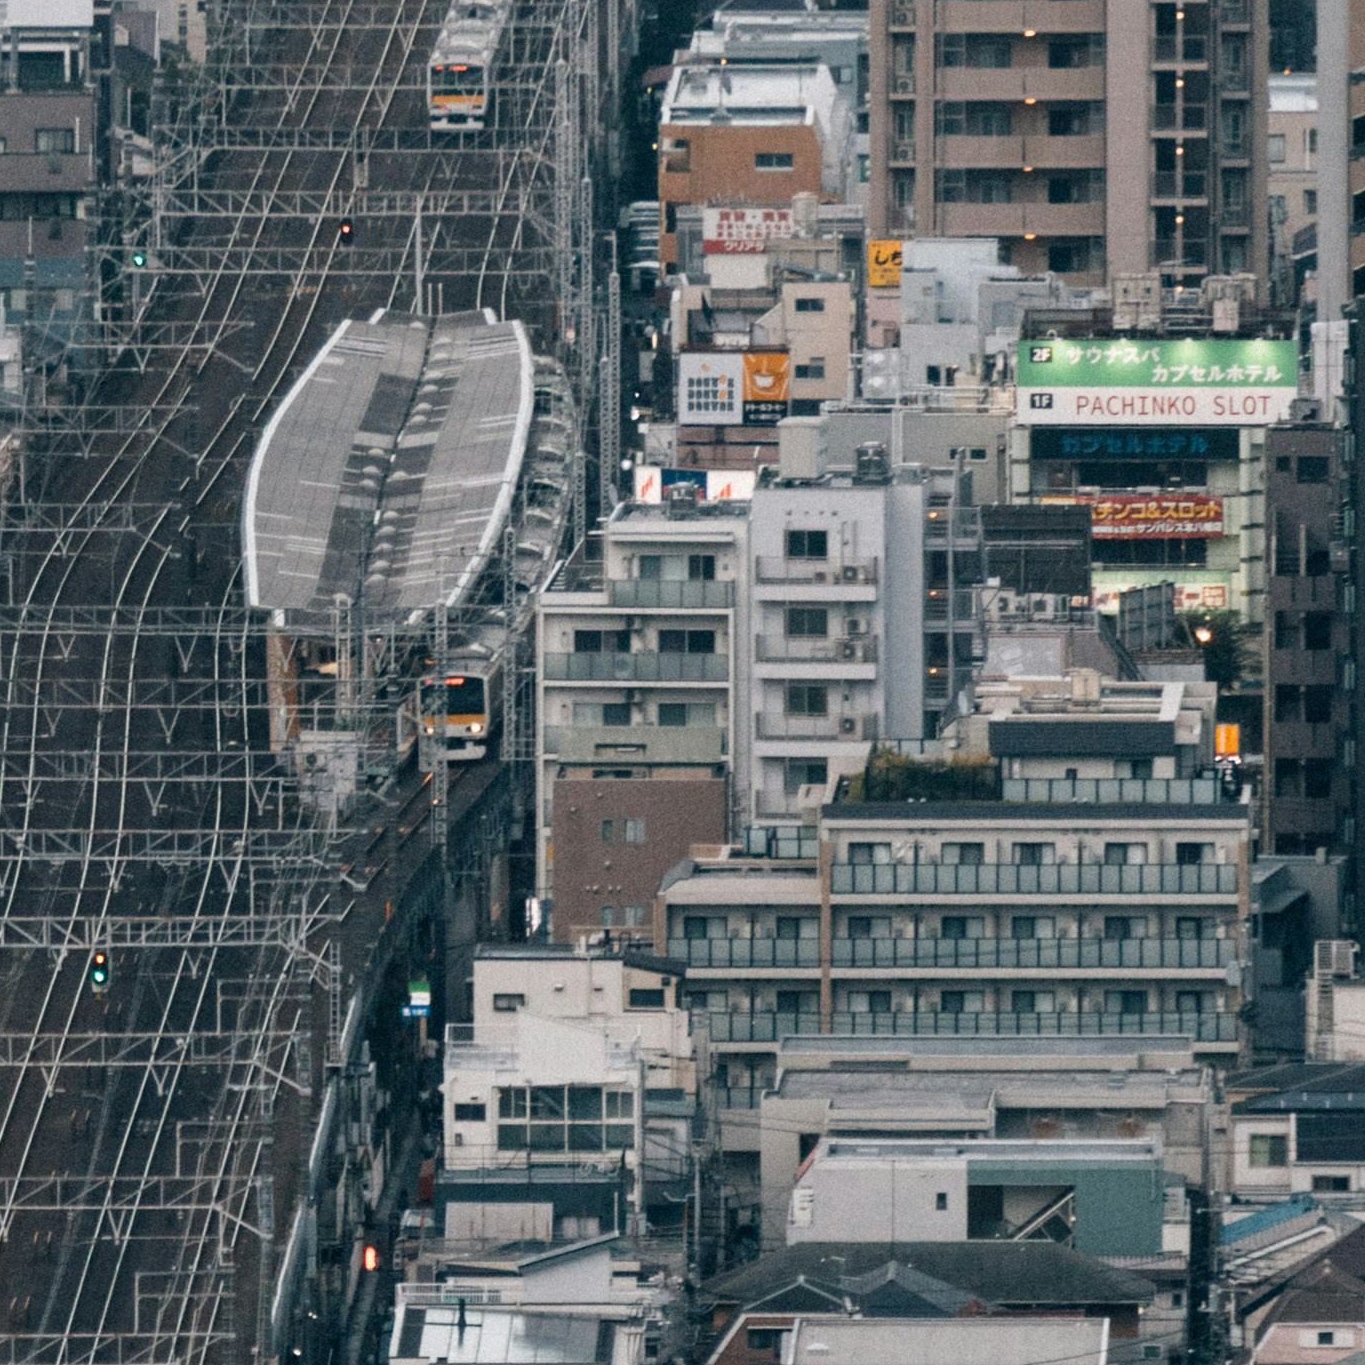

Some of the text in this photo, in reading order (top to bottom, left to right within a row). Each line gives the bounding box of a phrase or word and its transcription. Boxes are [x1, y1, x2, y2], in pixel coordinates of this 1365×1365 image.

[1031, 348, 1052, 362] 2F
[1151, 364, 1282, 383] カプセルホテル
[1032, 394, 1052, 408] 1F
[1075, 395, 1272, 416] PACHINKO SLOT
[1061, 434, 1209, 454] カプセルホテル
